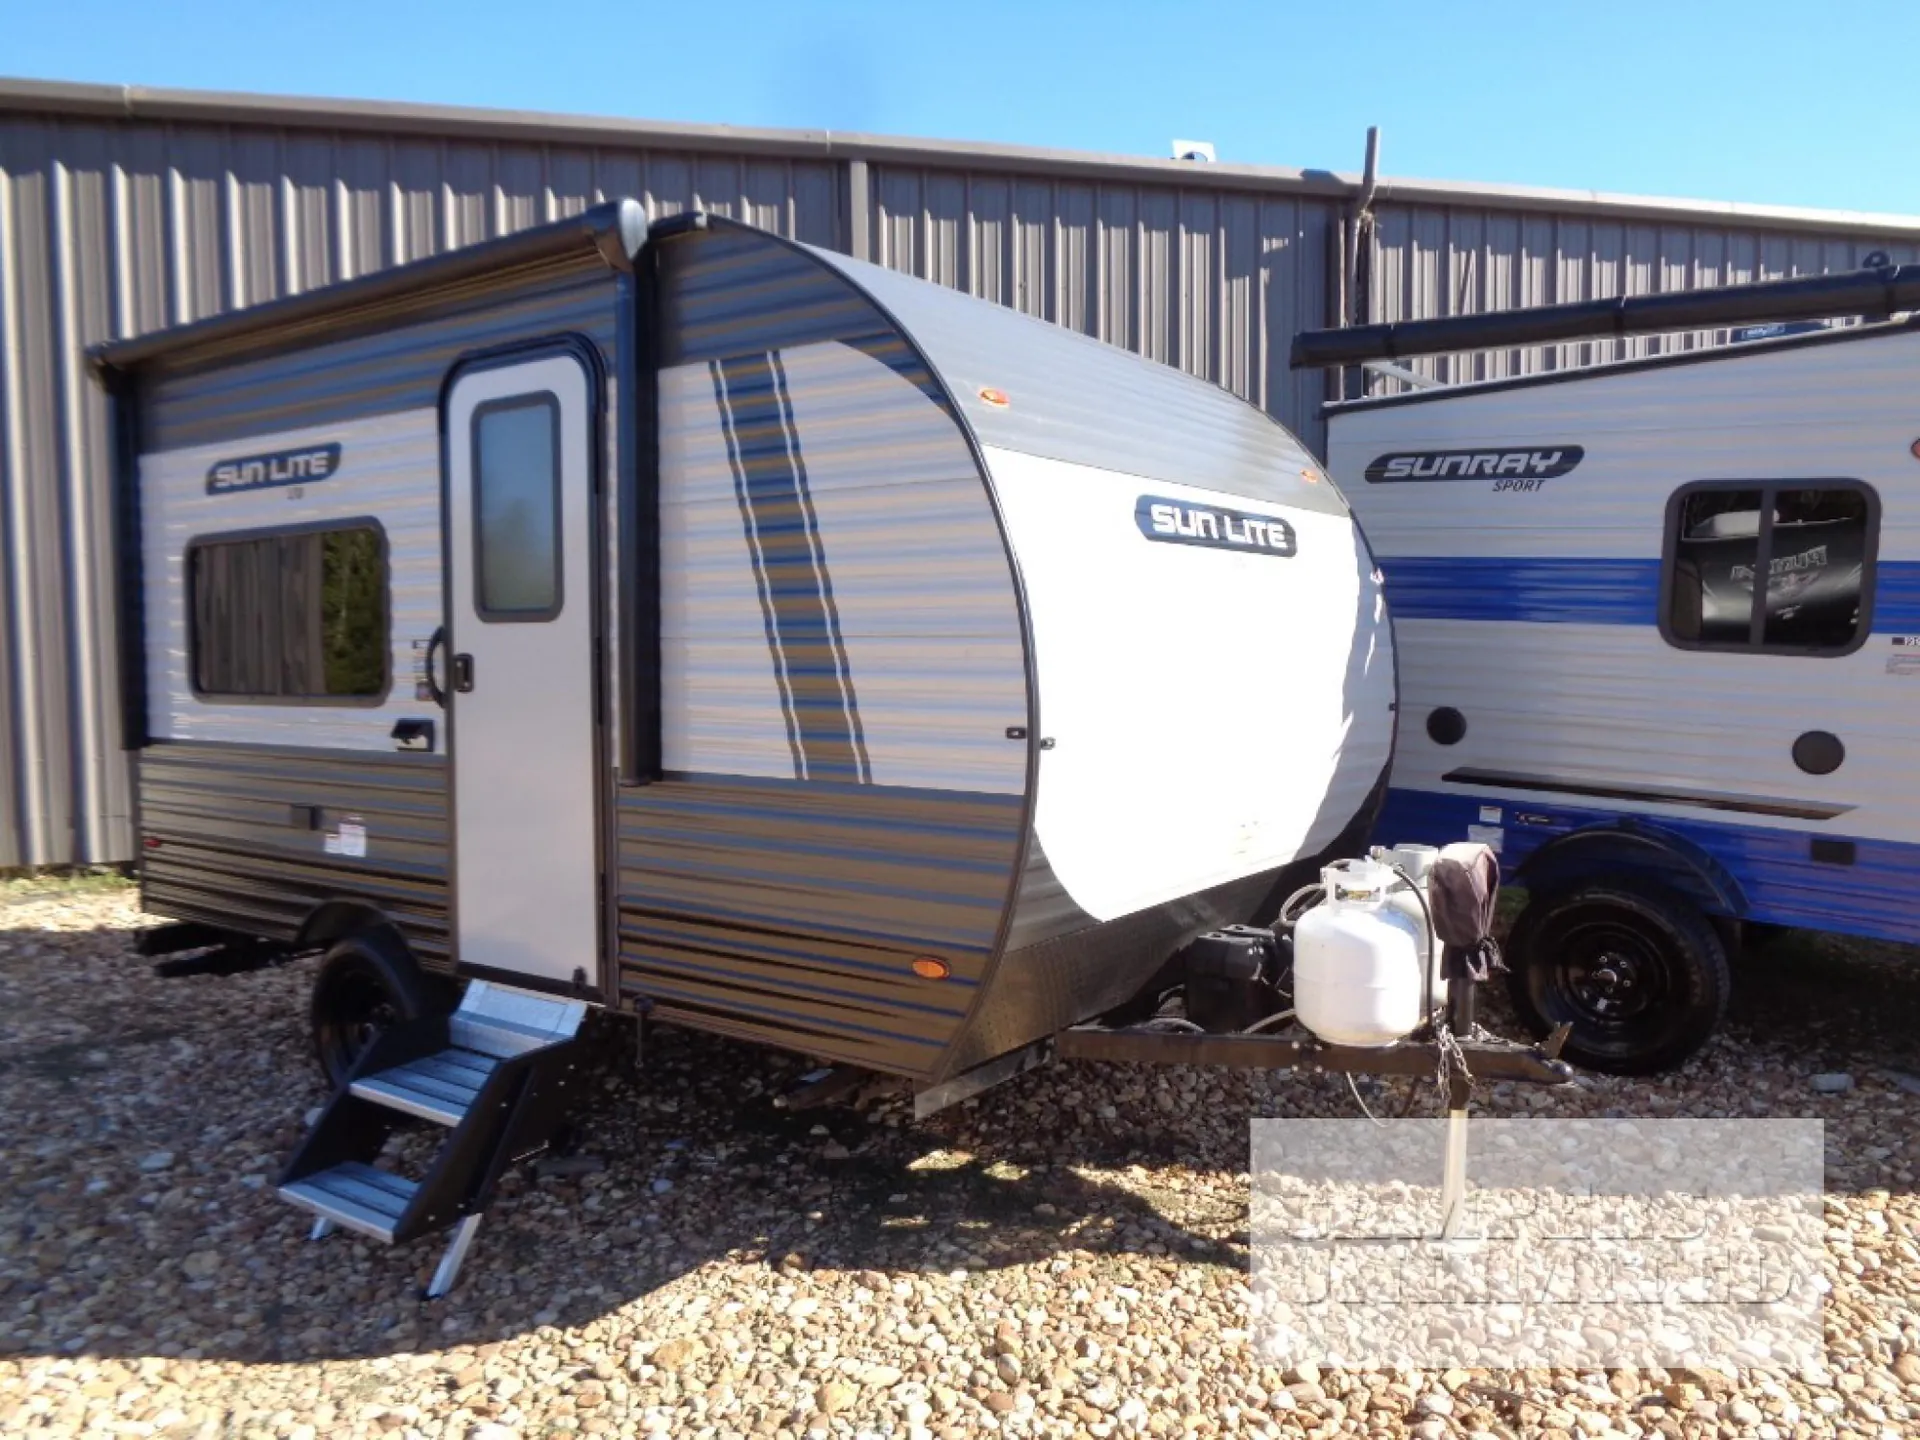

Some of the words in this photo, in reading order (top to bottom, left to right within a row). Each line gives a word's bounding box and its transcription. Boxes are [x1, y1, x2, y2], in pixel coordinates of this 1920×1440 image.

[214, 461, 264, 487] SUN
[269, 450, 330, 479] LITE
[1384, 450, 1563, 477] SUNRAY
[1492, 479, 1546, 492] SPORT
[1150, 503, 1220, 539] SUN
[1224, 514, 1289, 549] LITE
